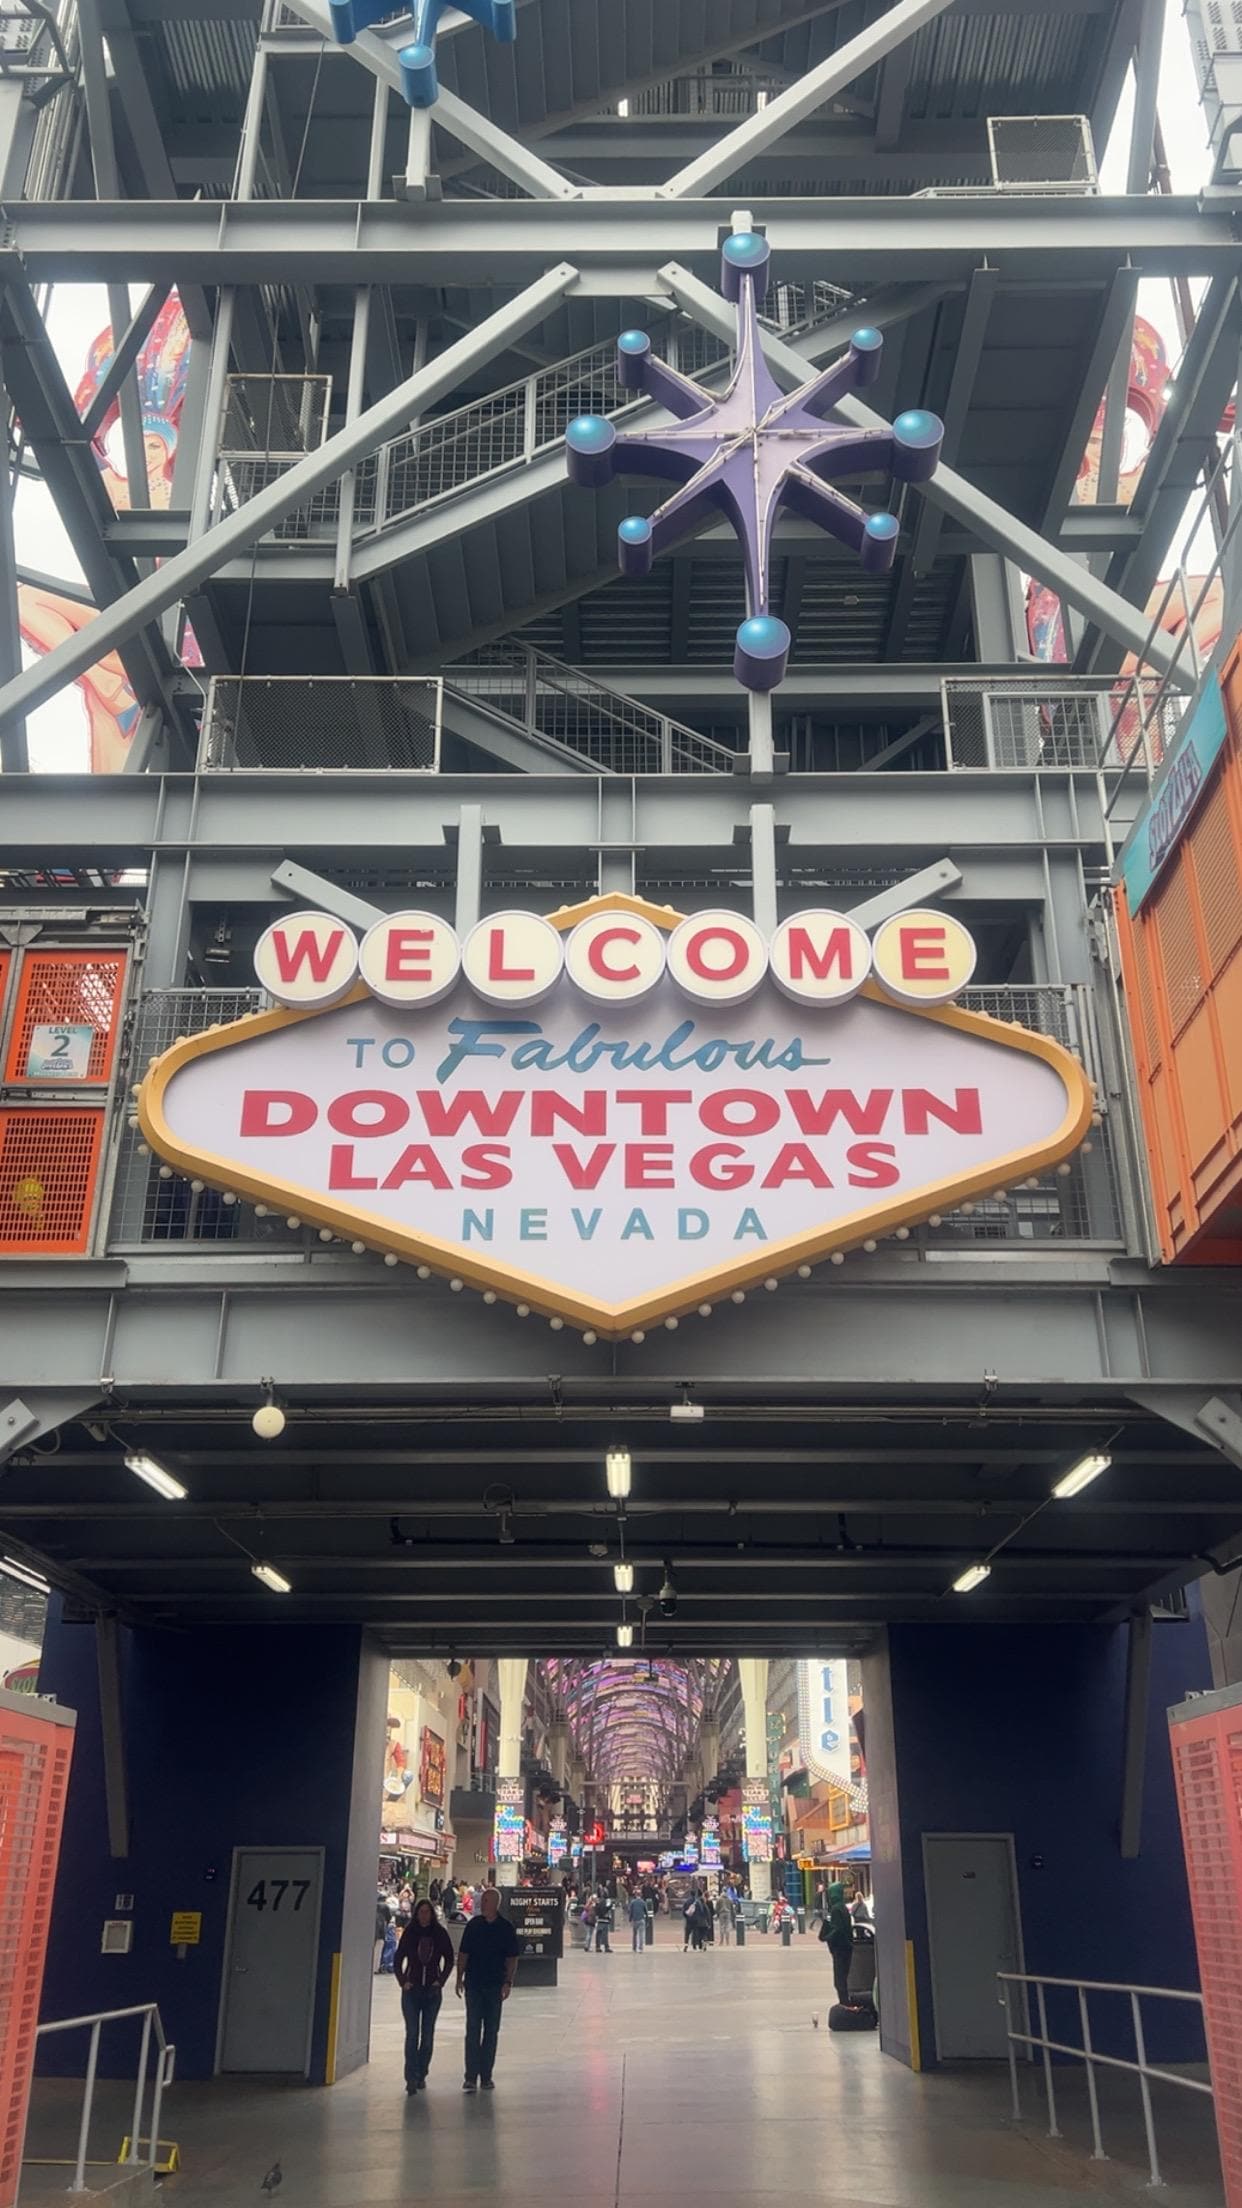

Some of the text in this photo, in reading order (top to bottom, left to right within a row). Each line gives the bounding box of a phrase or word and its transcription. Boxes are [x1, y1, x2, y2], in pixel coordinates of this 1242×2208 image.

[272, 926, 950, 982] WELCOME
[49, 1026, 78, 1034] LEVEL
[51, 1034, 70, 1057] 2
[346, 1017, 831, 1084] TO Fabulous
[239, 1089, 982, 1137] DOWNTOWN
[328, 1143, 900, 1191] LAS VEGAS
[462, 1207, 769, 1241] NEVADA
[247, 1880, 311, 1911] 477
[510, 1897, 559, 1906] NIGHT STARTS
